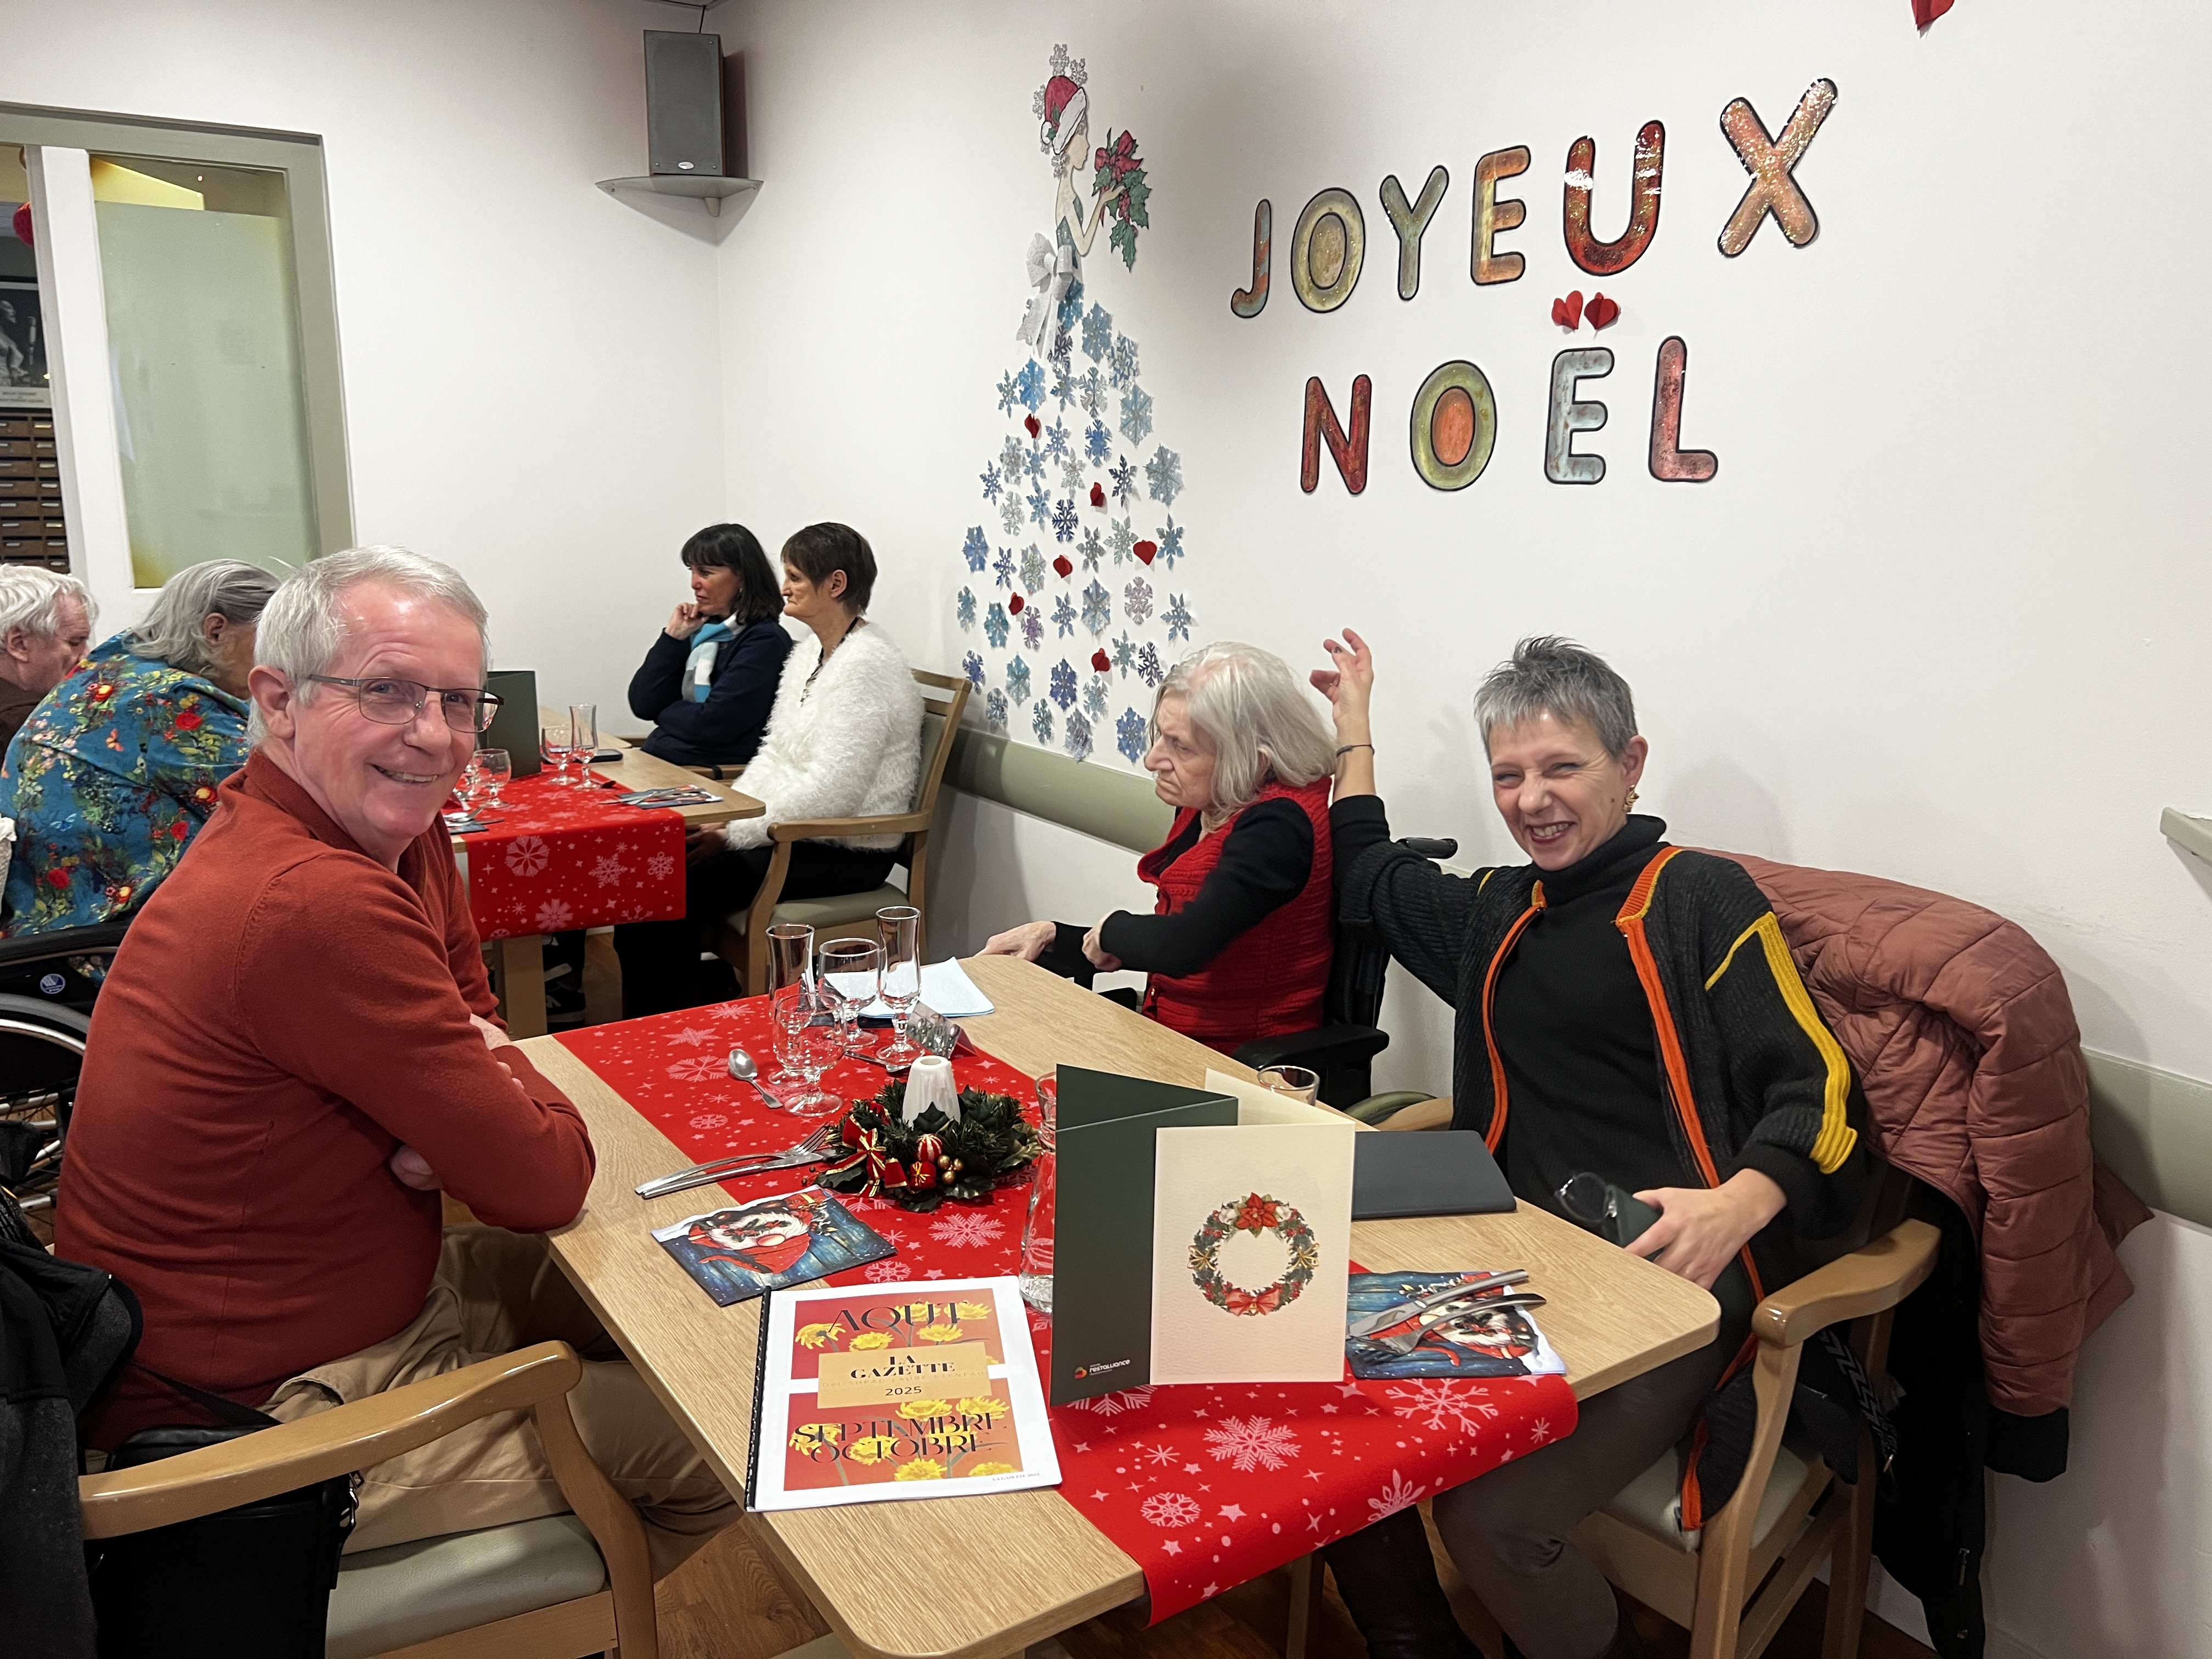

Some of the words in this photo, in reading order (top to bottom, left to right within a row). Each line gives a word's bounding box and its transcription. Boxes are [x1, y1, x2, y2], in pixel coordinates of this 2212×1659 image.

[1231, 76, 1839, 318] JOYEUX
[828, 1300, 968, 1333] AOÛT
[850, 1362, 956, 1379] GAZETTE
[890, 1355, 916, 1365] LA
[885, 1386, 922, 1396] 2025
[794, 1412, 1007, 1443] SEPTEMBRE
[810, 1432, 992, 1463] OCTOBRE
